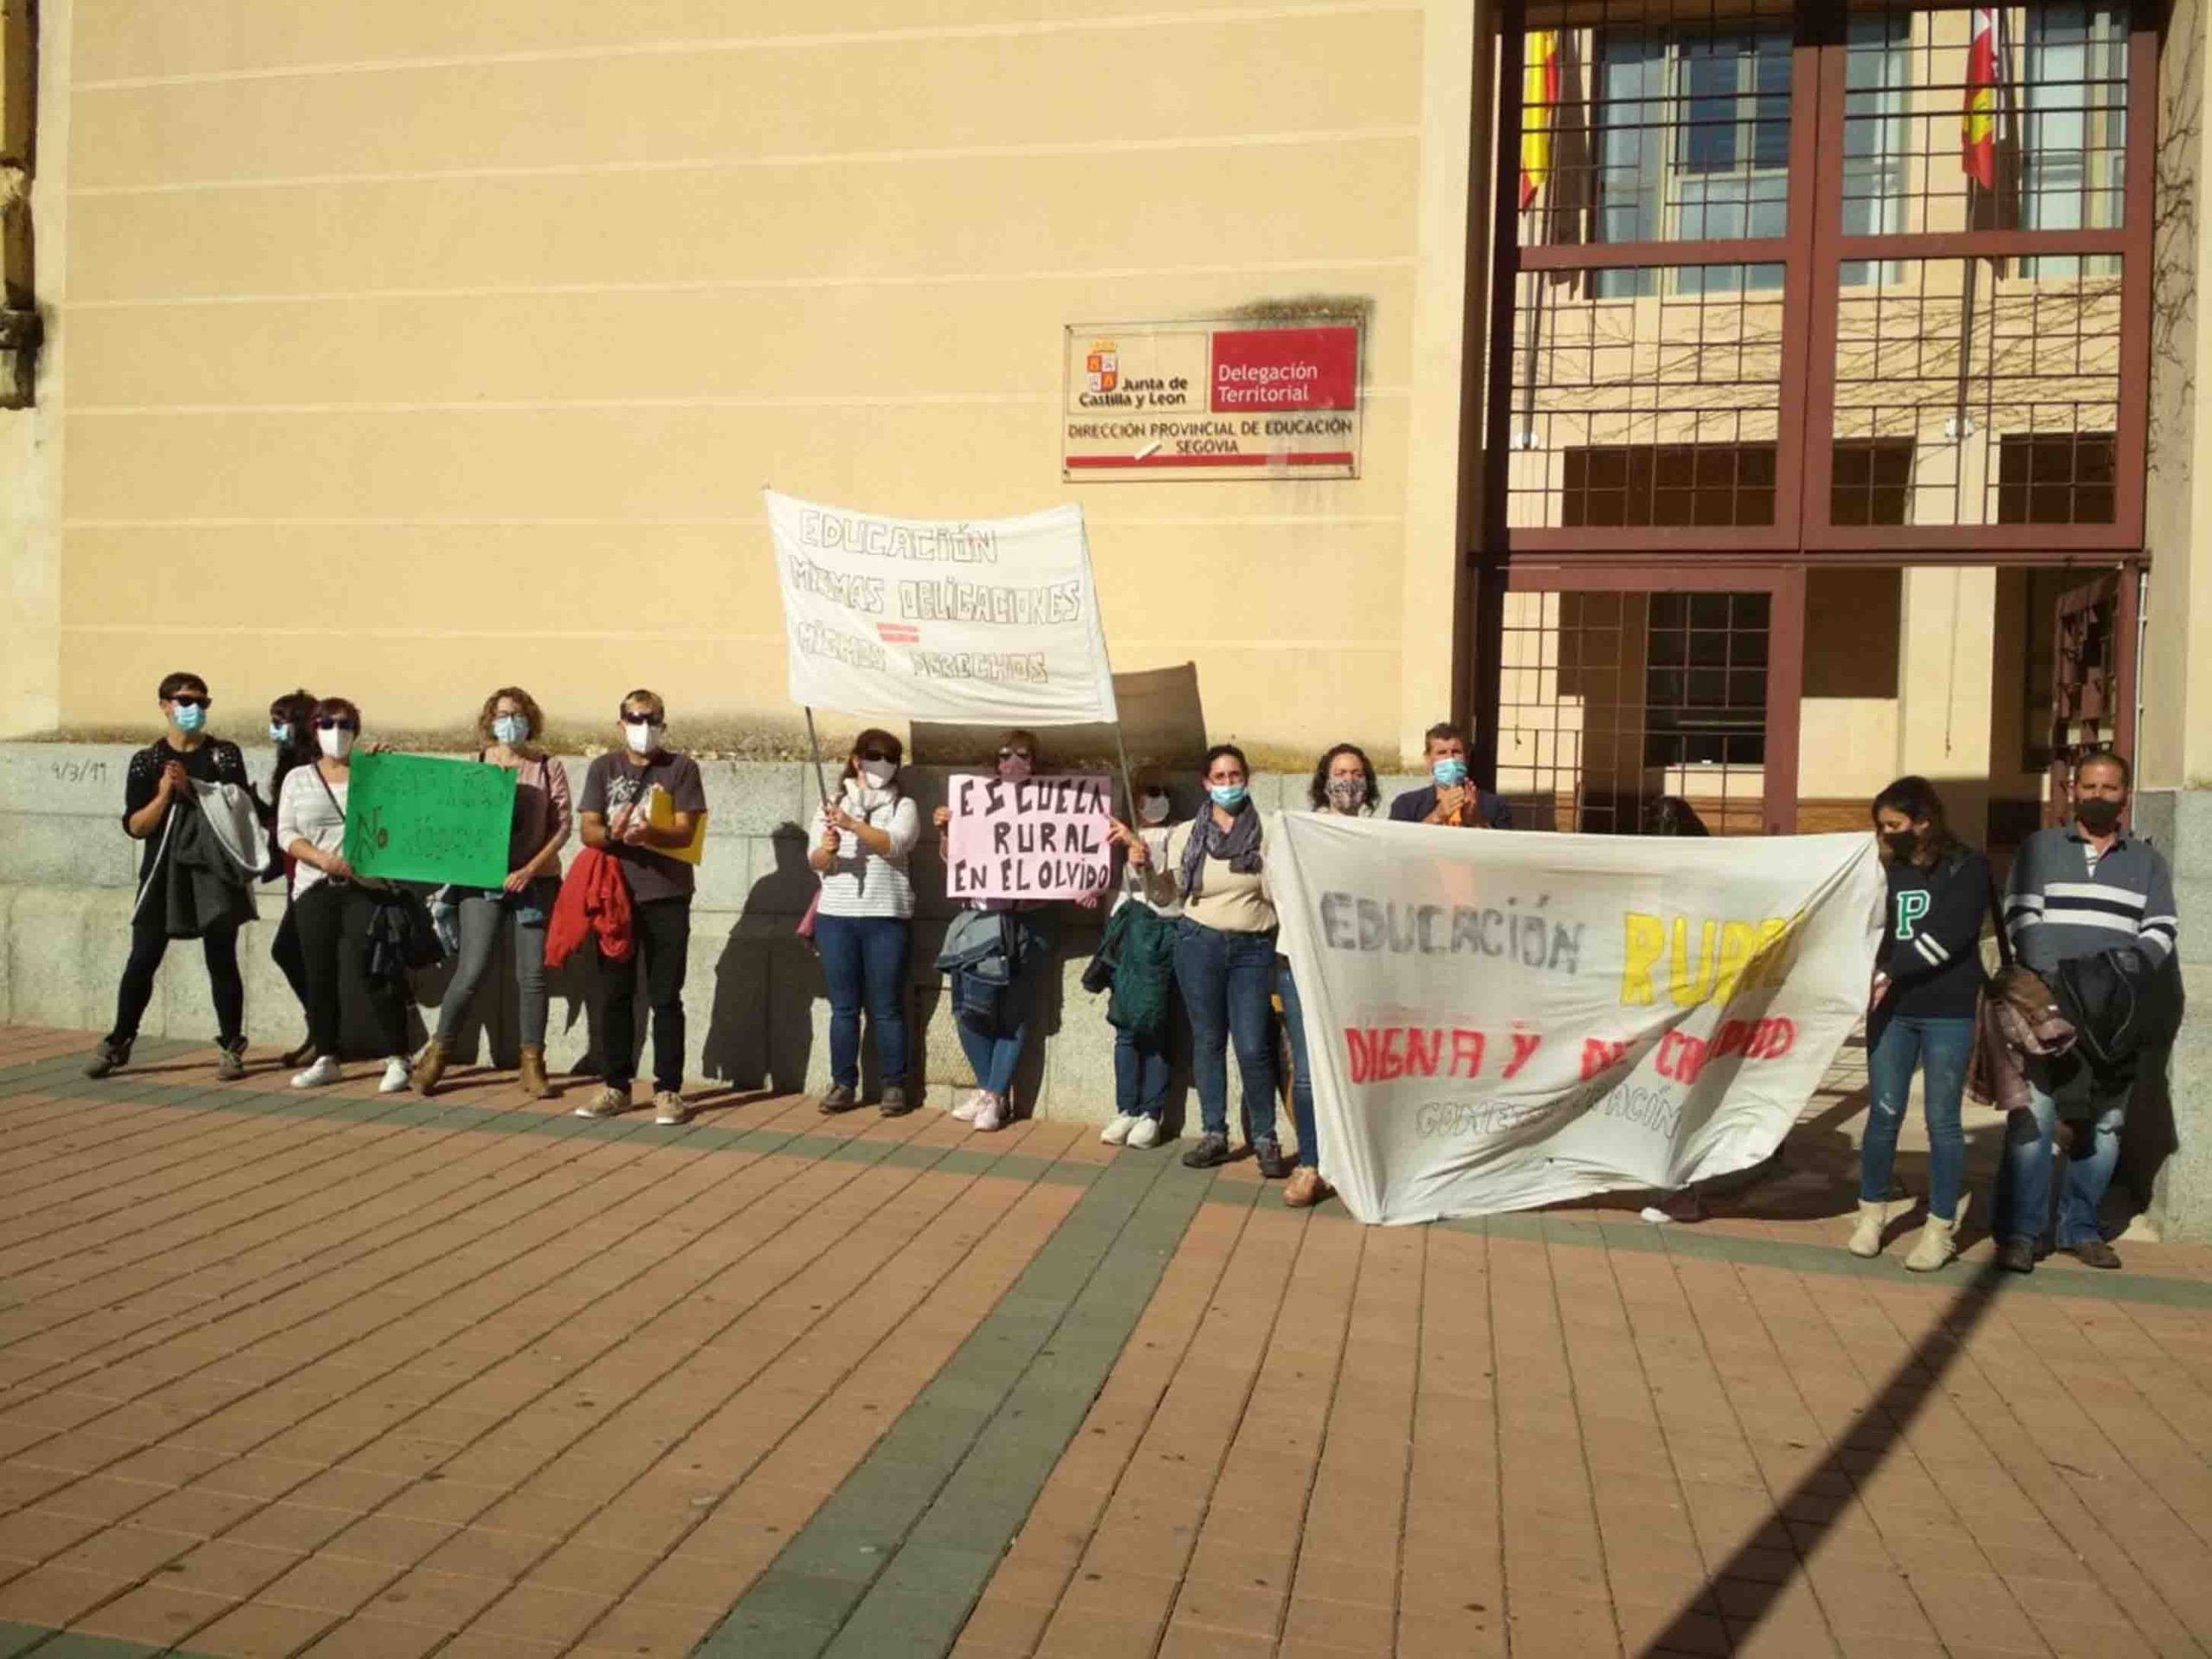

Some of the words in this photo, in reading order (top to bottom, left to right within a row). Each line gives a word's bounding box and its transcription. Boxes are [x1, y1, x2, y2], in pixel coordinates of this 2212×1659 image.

[1122, 377, 1164, 391] Junta
[1169, 376, 1188, 390] de
[1218, 360, 1318, 383] Delegación
[1079, 392, 1132, 407] Castilla
[1136, 394, 1145, 409] y
[1218, 384, 1309, 404] Territorial
[1150, 420, 1235, 437] PROVINCIAL
[1242, 420, 1259, 435] DE
[1266, 417, 1352, 435] EDUCACIÓN
[1177, 439, 1238, 454] SEGOVIA
[799, 510, 998, 563] EDUCACIÓN
[960, 779, 1104, 817] ESCUELA
[994, 822, 1100, 855] RURAL
[954, 859, 987, 892] EN
[1001, 857, 1031, 891] EL
[1038, 857, 1109, 889] OLVIDO
[1896, 889, 1931, 940] P
[1320, 893, 1585, 975] EDUCACIÓN
[1344, 1027, 1485, 1086] DIGNA
[1502, 1033, 1542, 1079] Y
